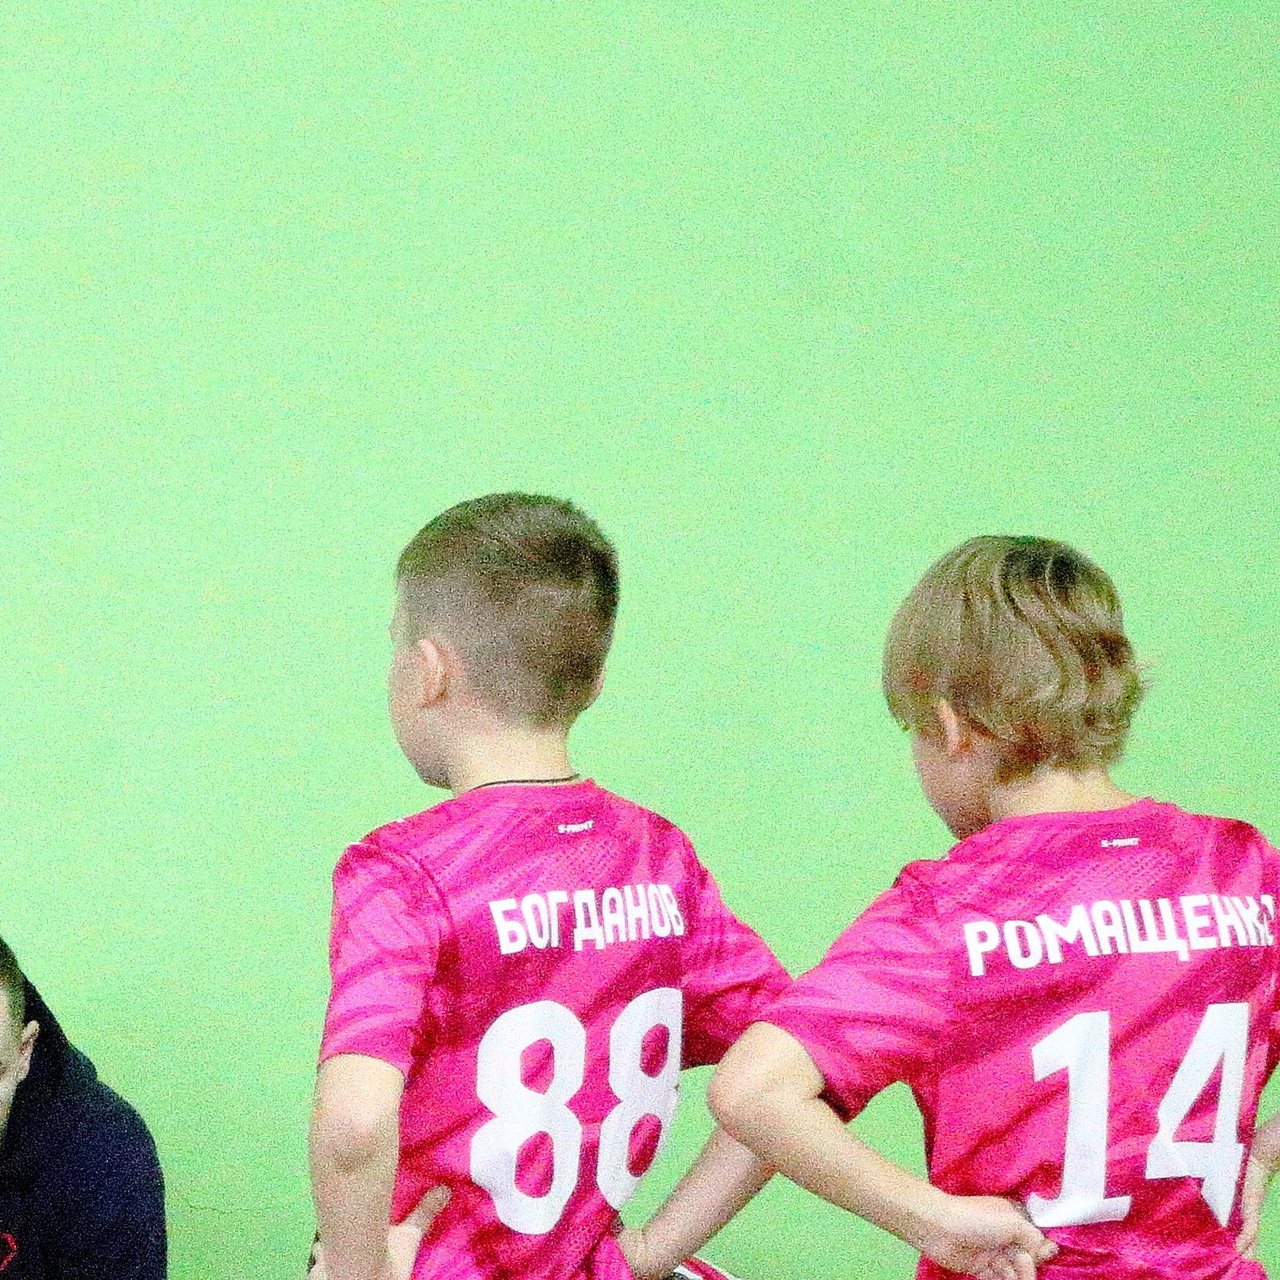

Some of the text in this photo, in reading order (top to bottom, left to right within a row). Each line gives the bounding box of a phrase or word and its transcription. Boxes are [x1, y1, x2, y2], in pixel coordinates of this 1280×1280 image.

[557, 820, 594, 834] S-PRINT
[489, 883, 685, 955] БОГДАНОВ
[470, 987, 684, 1236] 88
[1026, 1001, 1250, 1228] 14
